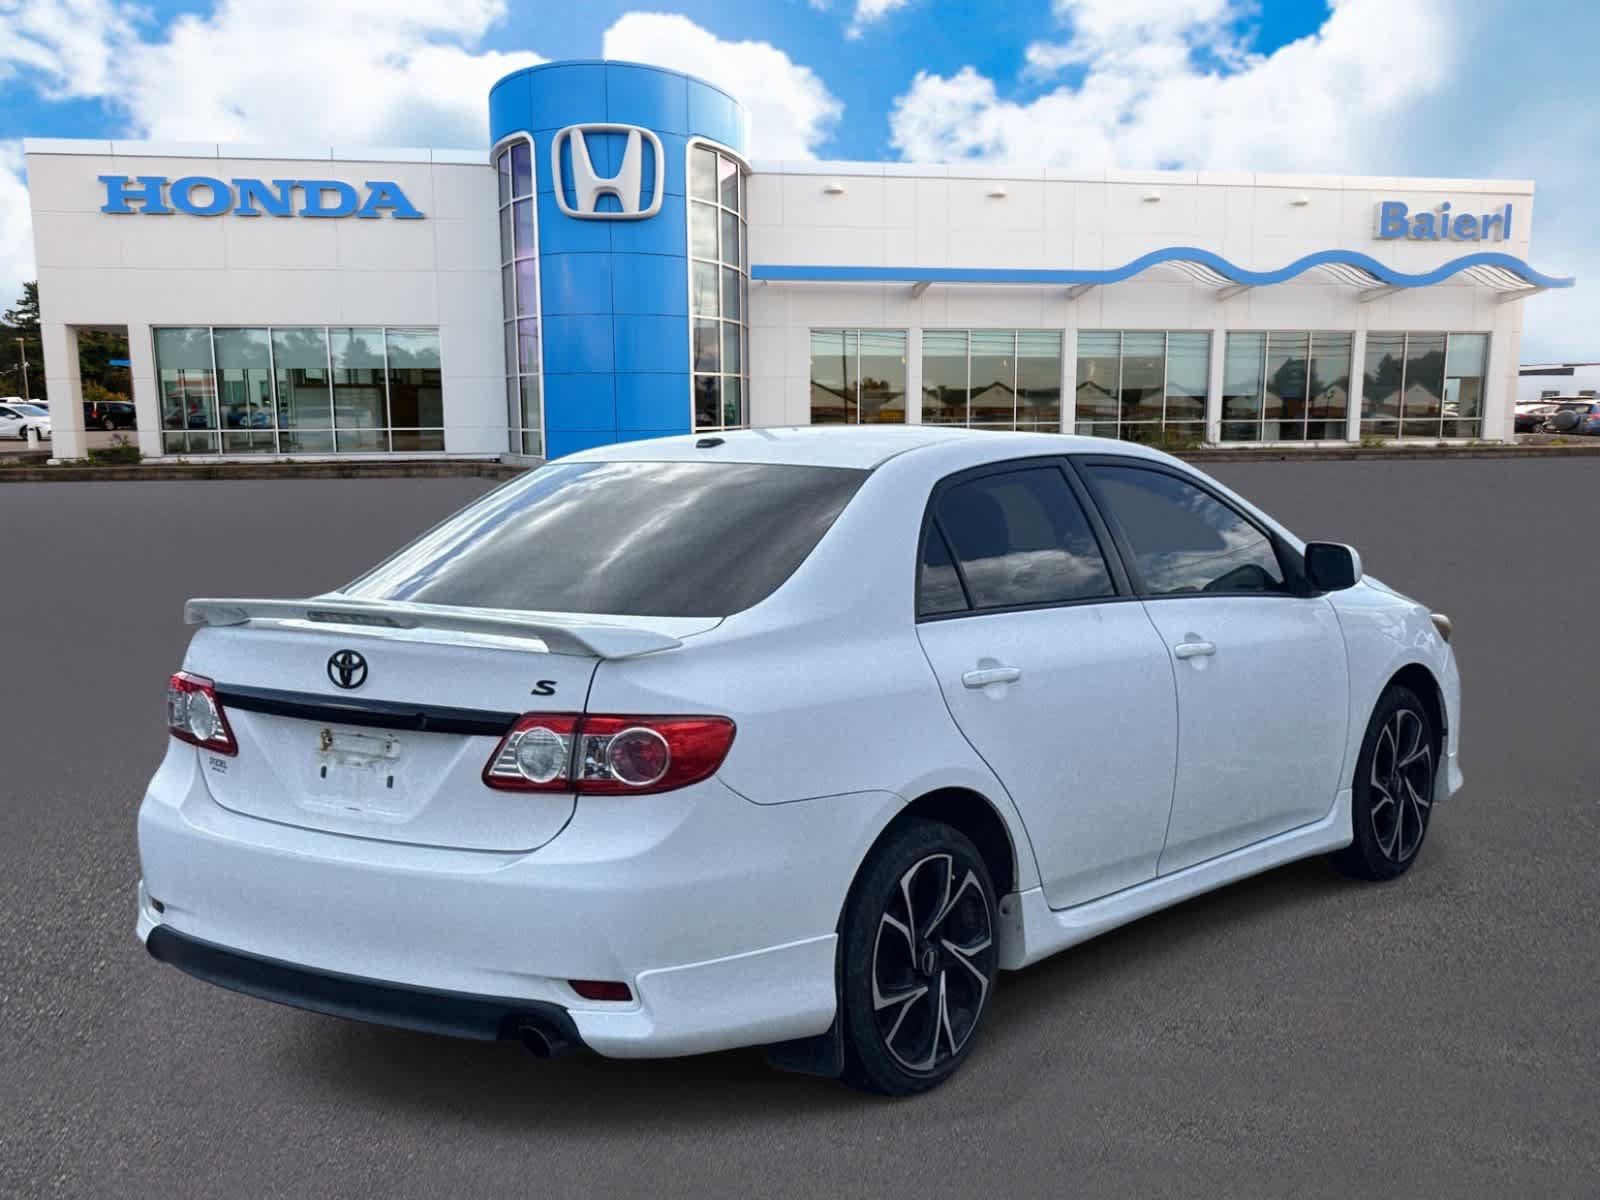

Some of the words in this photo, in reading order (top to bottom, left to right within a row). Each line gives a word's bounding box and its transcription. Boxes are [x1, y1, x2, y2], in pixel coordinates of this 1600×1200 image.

[97, 175, 425, 219] HONDA
[1377, 200, 1513, 240] Baierl
[530, 680, 558, 697] S
